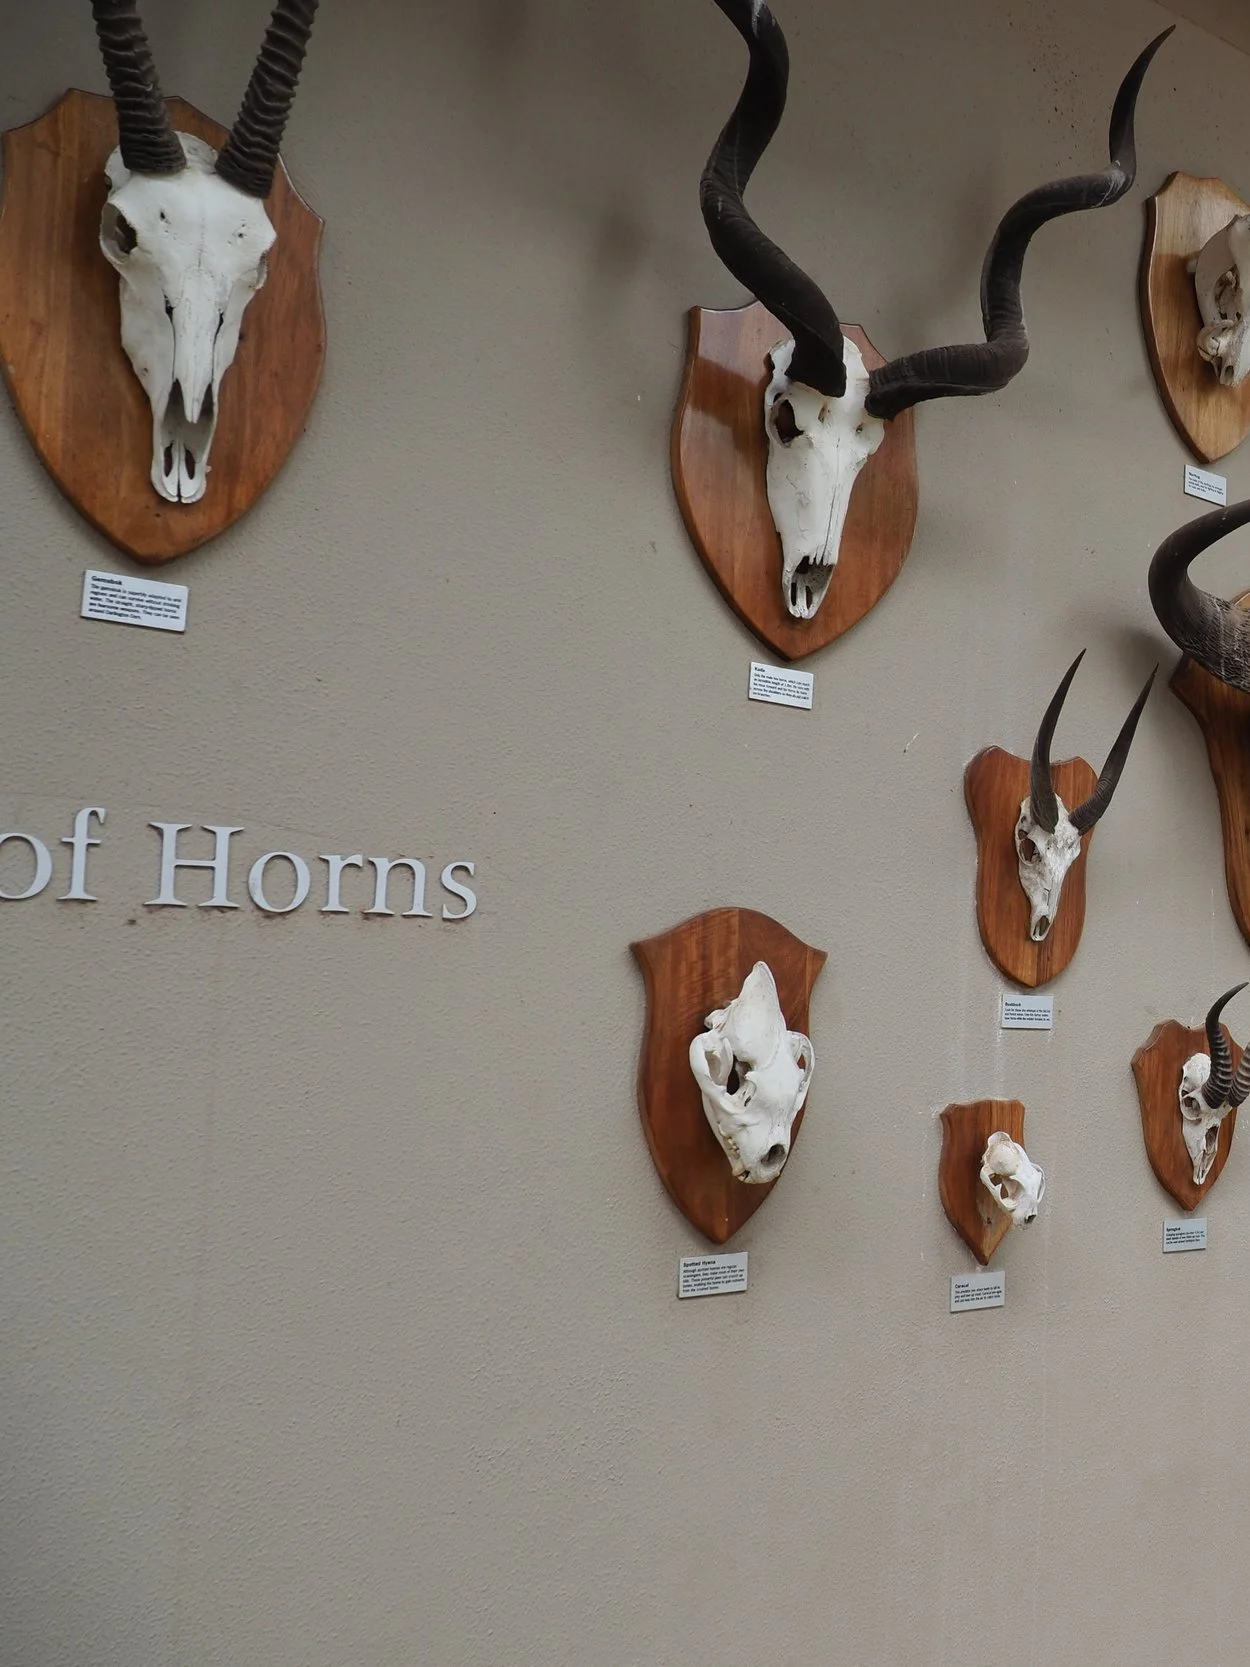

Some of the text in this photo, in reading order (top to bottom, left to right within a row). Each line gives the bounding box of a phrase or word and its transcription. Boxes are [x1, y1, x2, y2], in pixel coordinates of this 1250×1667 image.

[92, 576, 122, 585] Gemsbok
[0, 807, 477, 919] of Horns
